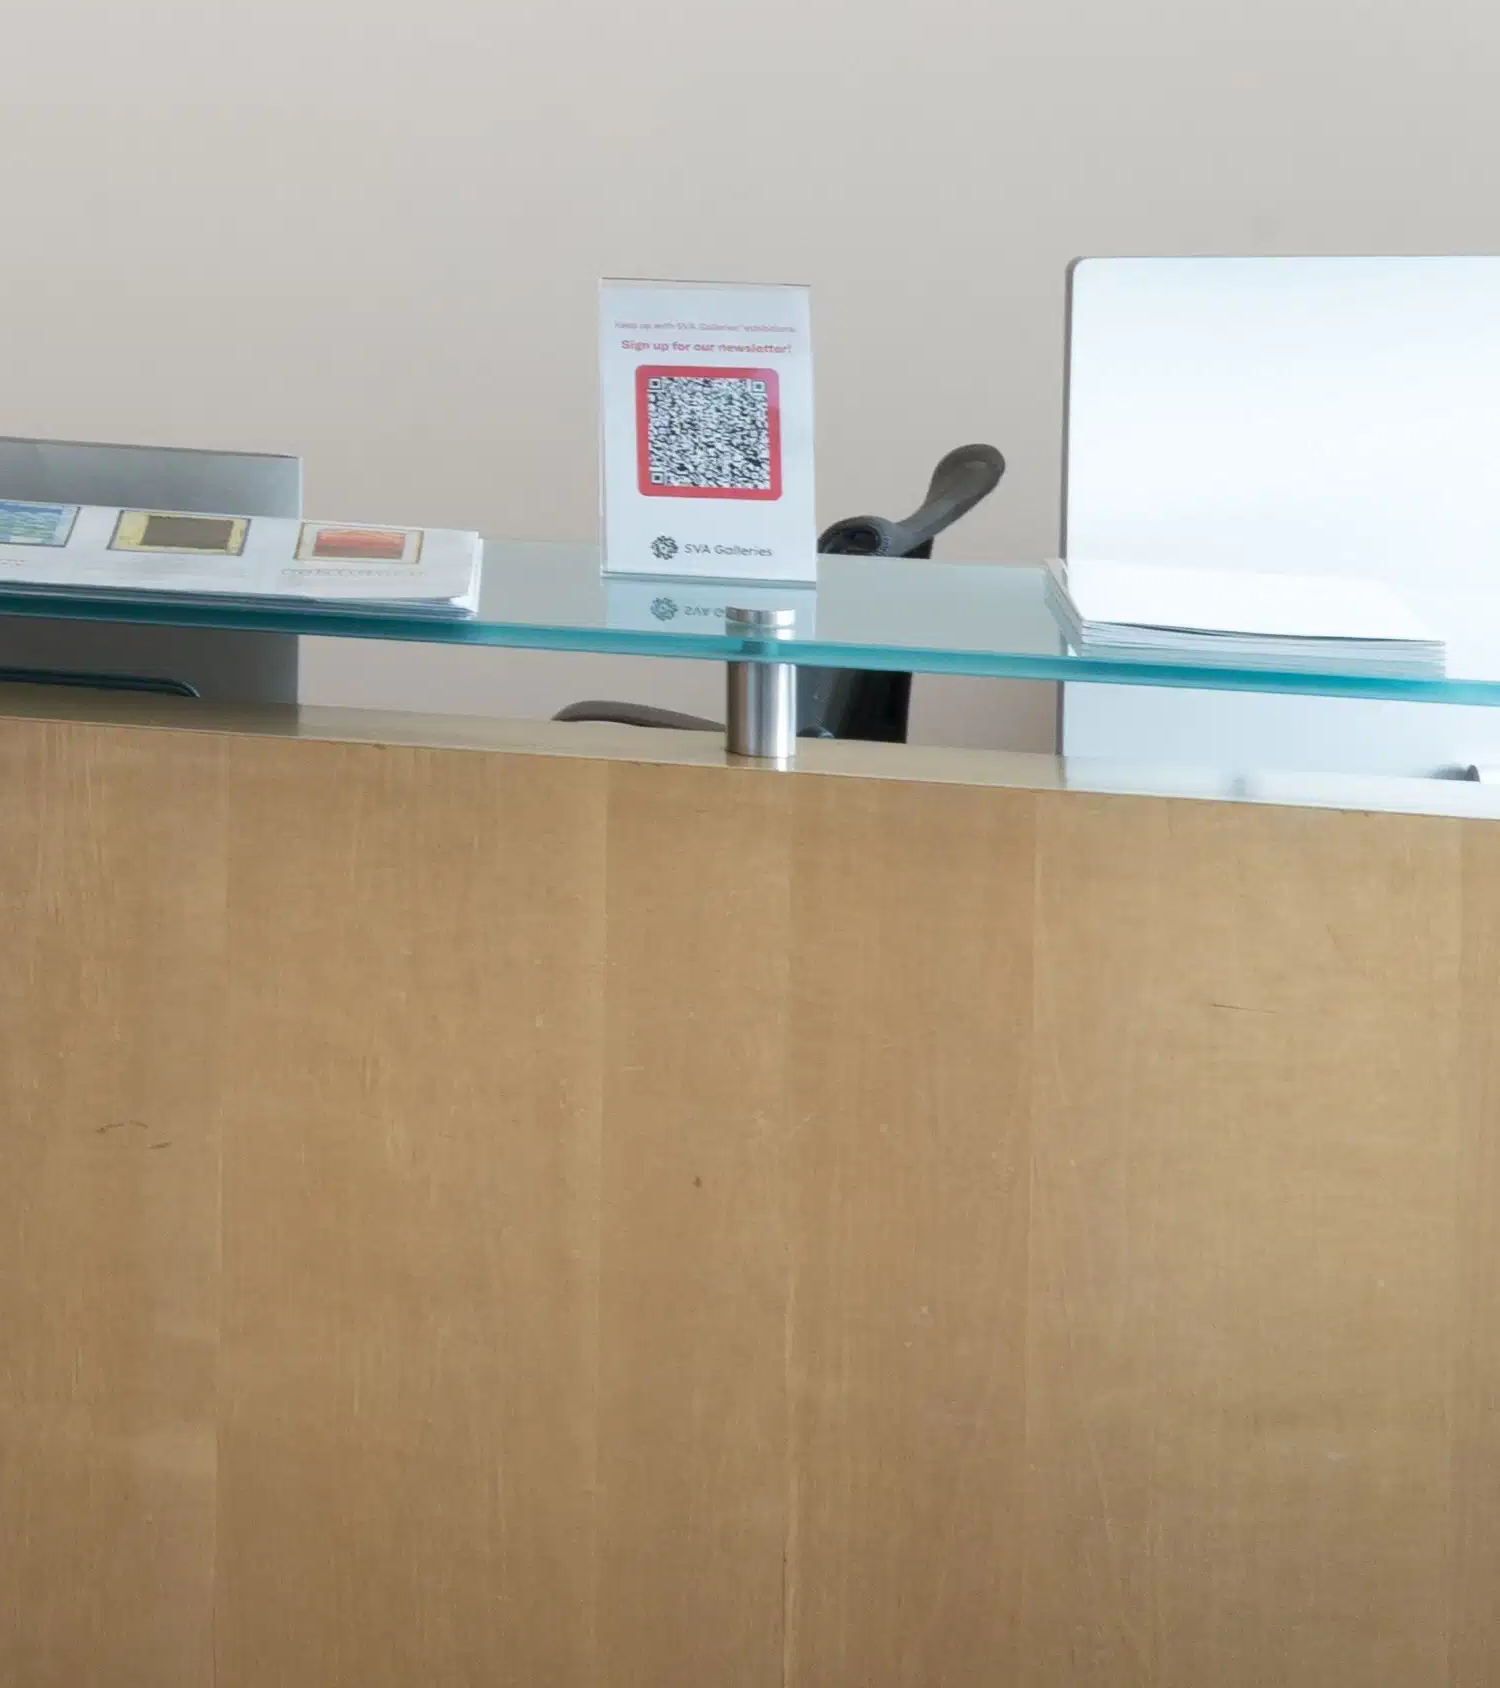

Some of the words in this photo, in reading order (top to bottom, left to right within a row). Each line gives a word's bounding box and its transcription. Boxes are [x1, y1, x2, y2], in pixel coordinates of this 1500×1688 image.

[621, 340, 650, 352] Sign
[653, 343, 669, 353] up
[672, 341, 690, 352] for
[693, 344, 714, 352] our
[684, 543, 711, 554] SVA
[715, 545, 773, 557] Galleries
